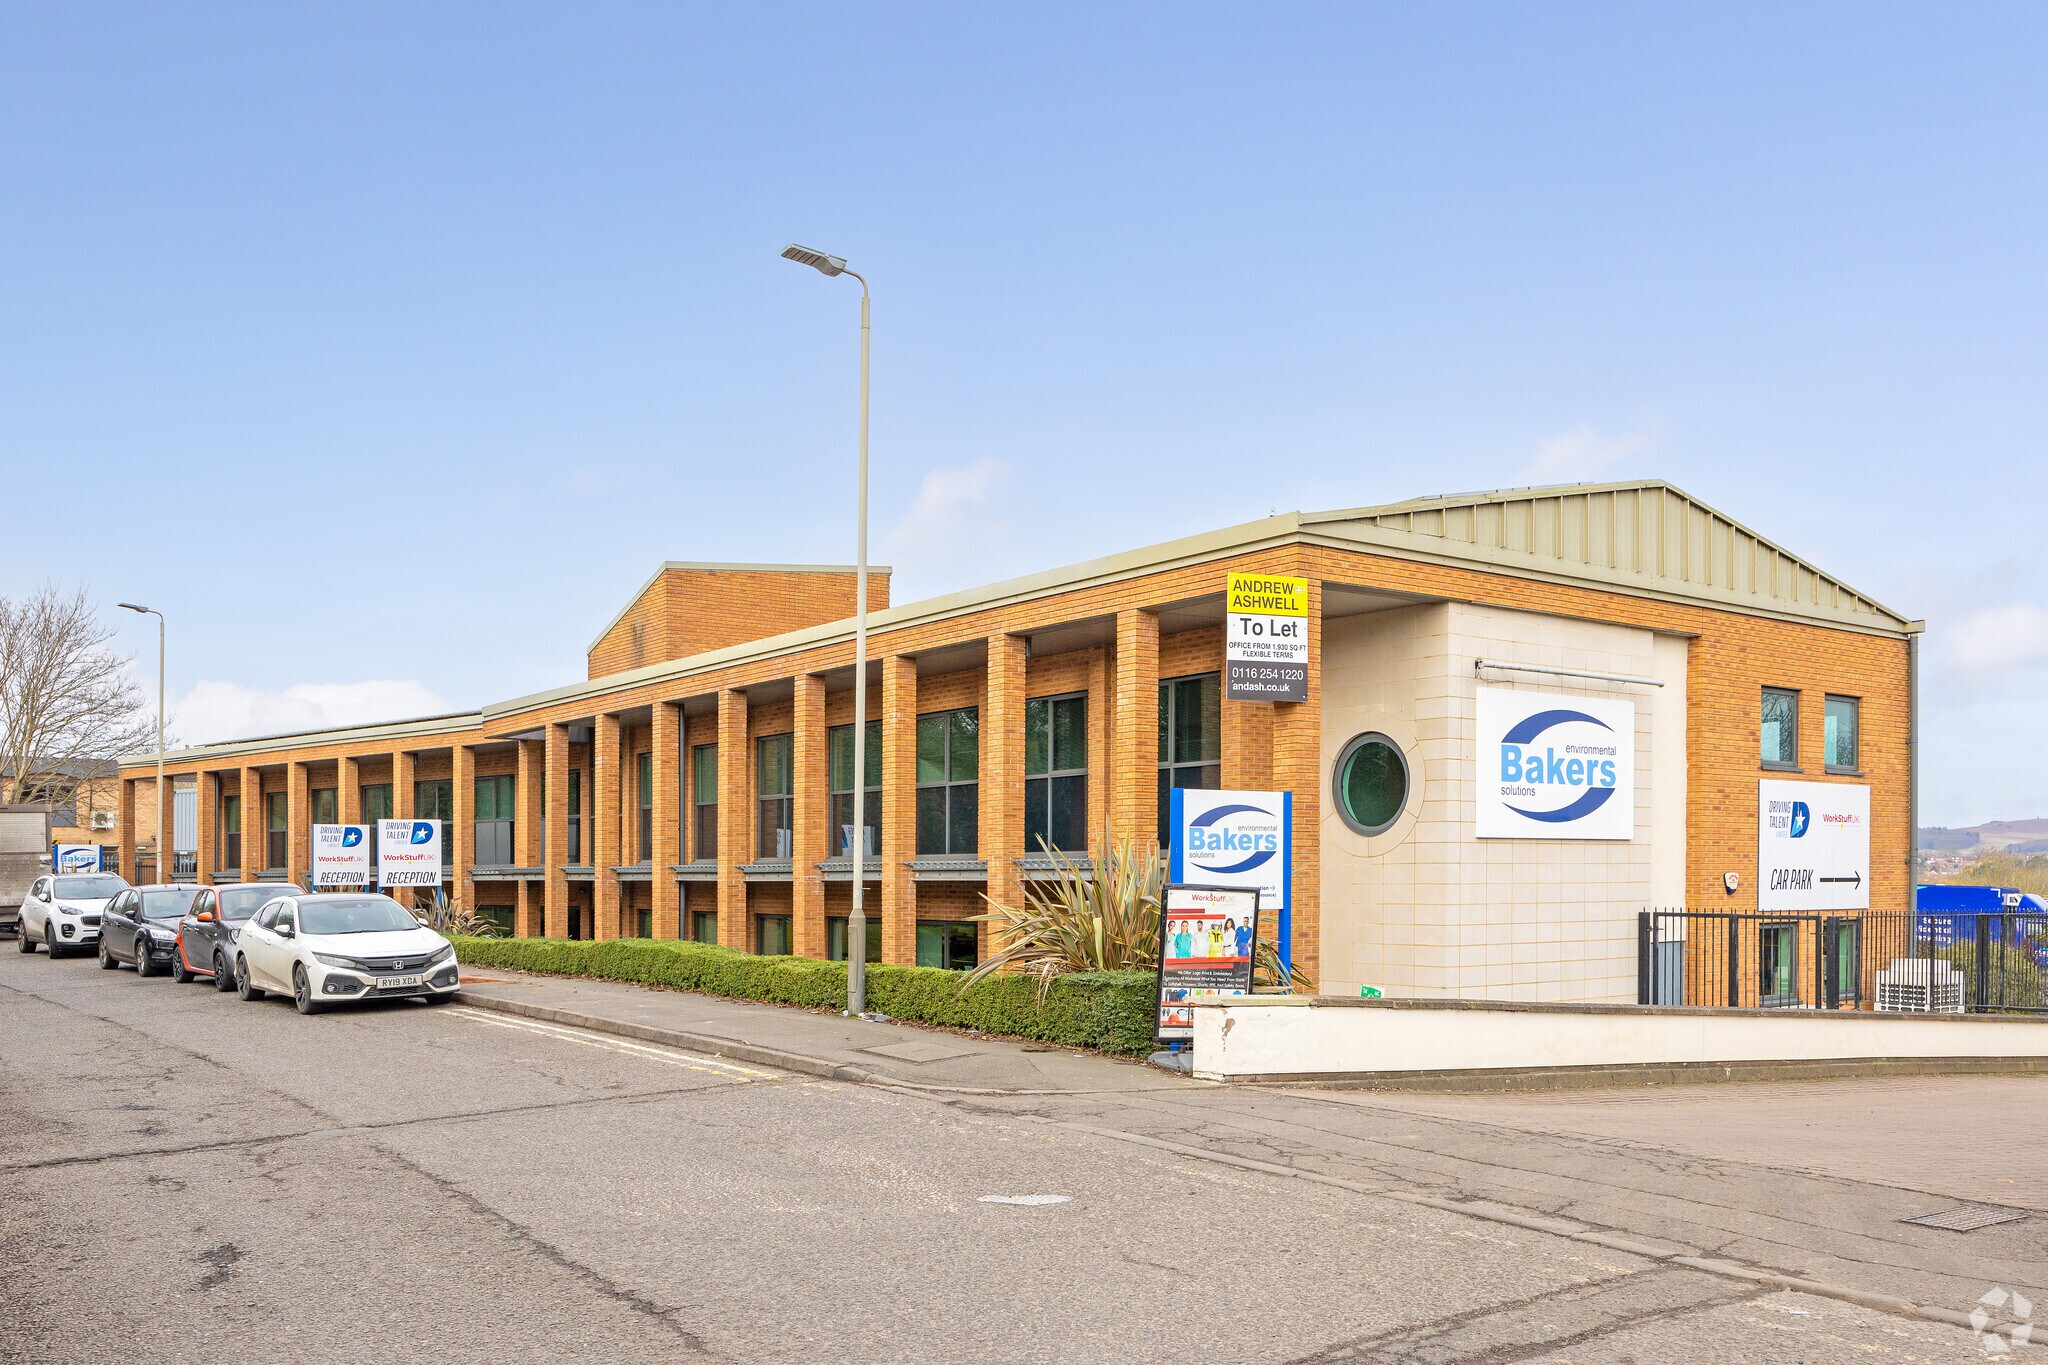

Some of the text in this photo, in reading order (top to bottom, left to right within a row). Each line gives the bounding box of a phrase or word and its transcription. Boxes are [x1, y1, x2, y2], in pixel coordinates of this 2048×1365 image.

[1232, 579, 1294, 595] ANDREW
[1232, 594, 1299, 611] ASHWELL
[1240, 617, 1298, 638] To Let
[1243, 650, 1294, 659] FLEXIBLE TERMS
[1232, 667, 1303, 680] 0116 254 1220
[1232, 681, 1290, 692] andash.co.uk
[1566, 743, 1616, 756] environmental
[1501, 744, 1616, 787] Bakers
[1500, 785, 1536, 797] solutions
[1769, 800, 1791, 813] DRIVING
[385, 822, 412, 830] DRIVING
[1769, 815, 1789, 829] TALENT
[320, 835, 341, 843] TALENT
[386, 831, 409, 839] TALENT
[1189, 828, 1278, 851] Bakers
[1189, 851, 1215, 859] solutions
[320, 871, 365, 883] RECEPTION
[386, 871, 436, 884] RECEPTION
[1770, 868, 1814, 890] CAR PARK
[382, 978, 400, 987] RY19
